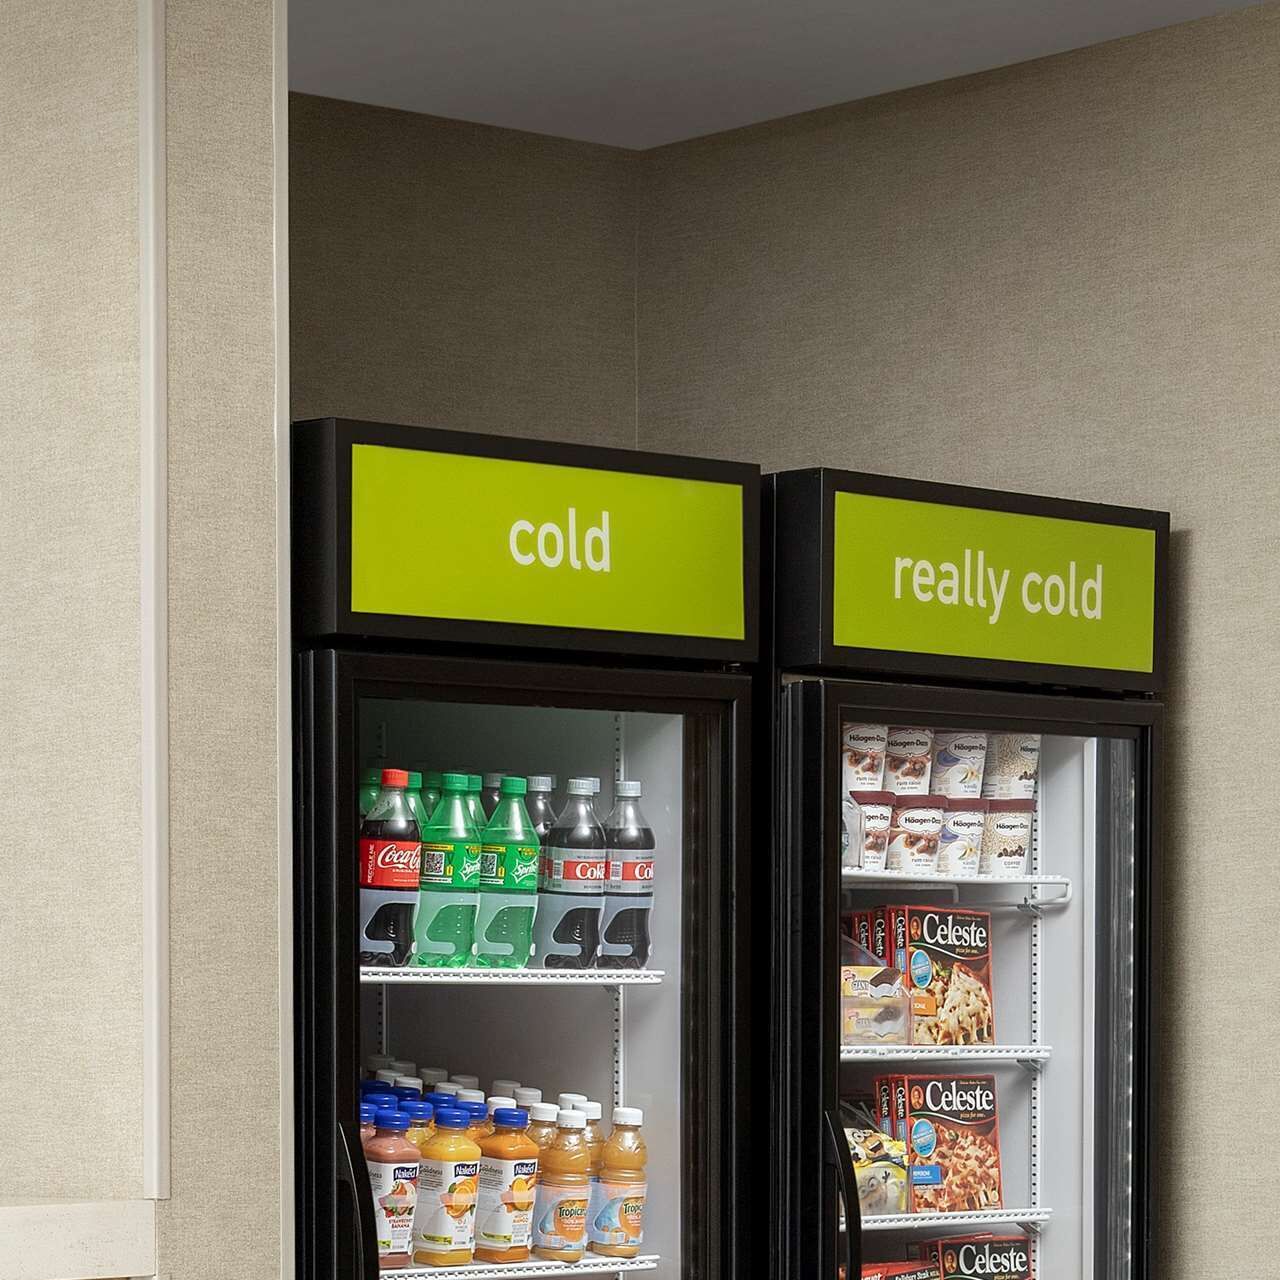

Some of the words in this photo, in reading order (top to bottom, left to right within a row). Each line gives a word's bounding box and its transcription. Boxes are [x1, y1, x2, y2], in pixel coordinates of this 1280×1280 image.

[509, 507, 611, 572] cold
[894, 548, 1009, 625] really
[1022, 563, 1103, 621] cold
[896, 916, 906, 949] Celeste
[923, 913, 987, 948] Celeste
[896, 1087, 906, 1119] Celeste
[925, 1081, 994, 1112] Celeste
[959, 1244, 1029, 1275] Celeste
